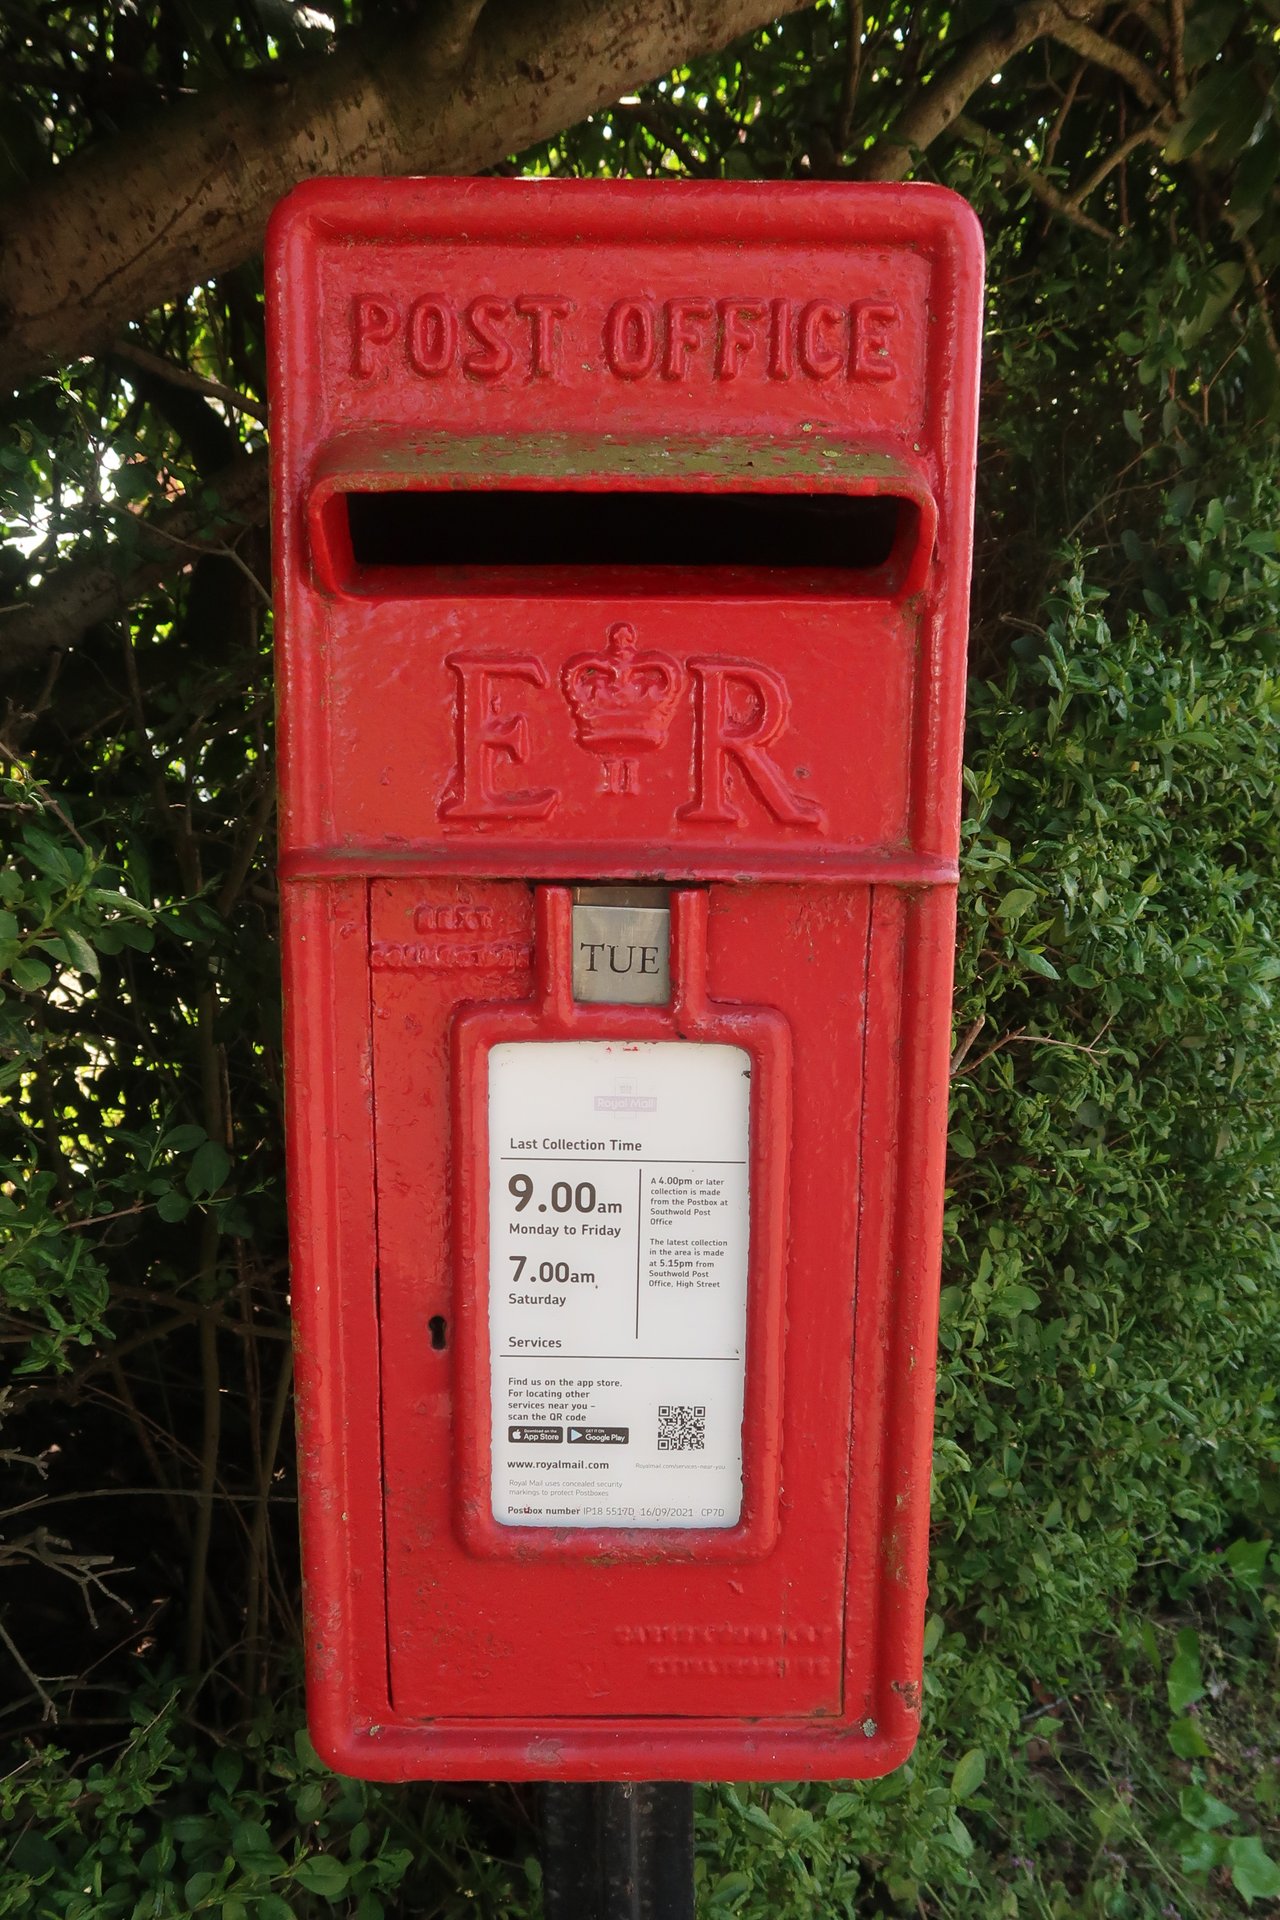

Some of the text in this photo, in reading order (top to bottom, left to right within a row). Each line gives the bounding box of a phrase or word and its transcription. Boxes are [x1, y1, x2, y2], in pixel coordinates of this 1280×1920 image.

[349, 294, 900, 384] POST OFFICE
[435, 650, 561, 822] E
[674, 655, 829, 835] R
[581, 942, 660, 974] TUE
[597, 1098, 655, 1110] Royal Mail
[510, 1137, 643, 1152] Last Collection Time
[650, 1177, 657, 1185] A
[658, 1176, 693, 1187] 4.00pm
[705, 1178, 725, 1186] later
[509, 1174, 622, 1213] 9.00am
[650, 1187, 721, 1196] collection is made
[650, 1197, 670, 1206] from
[671, 1198, 685, 1206] the
[686, 1198, 718, 1206] Postbox
[650, 1207, 711, 1216] Southwold Post
[649, 1217, 673, 1226] Office
[510, 1223, 621, 1238] Monday to Friday
[649, 1237, 728, 1247] The latest collection
[649, 1248, 657, 1256] in
[659, 1248, 673, 1256] the
[693, 1247, 701, 1257] is
[702, 1249, 725, 1257] made
[509, 1256, 594, 1283] 7.00am
[659, 1258, 694, 1269] 5.15pm
[695, 1260, 715, 1268] from
[648, 1269, 710, 1278] Southwold Post
[648, 1279, 721, 1289] Office, High Street
[509, 1293, 566, 1307] Saturday
[508, 1336, 562, 1349] Services
[508, 1376, 623, 1389] Find us on the app store.
[508, 1388, 591, 1400] For locating other
[507, 1400, 545, 1410] services
[547, 1402, 570, 1410] near
[571, 1403, 588, 1412] you
[531, 1412, 547, 1421] the
[549, 1412, 563, 1422] QR
[565, 1413, 587, 1422] code
[524, 1432, 559, 1441] App Store
[585, 1434, 625, 1442] Google Play
[506, 1459, 610, 1471] www.royalmail.com
[508, 1478, 528, 1488] Royal
[528, 1479, 544, 1488] Mail
[561, 1480, 596, 1488] concealed
[596, 1481, 623, 1490] security
[508, 1488, 541, 1497] markings
[549, 1489, 574, 1497] protect
[575, 1488, 609, 1497] Postboxes
[507, 1506, 543, 1515] Postbox
[545, 1506, 581, 1515] number
[583, 1506, 605, 1516] IP18
[639, 1507, 694, 1518] 16/09/2021
[700, 1507, 725, 1518] CP7D
